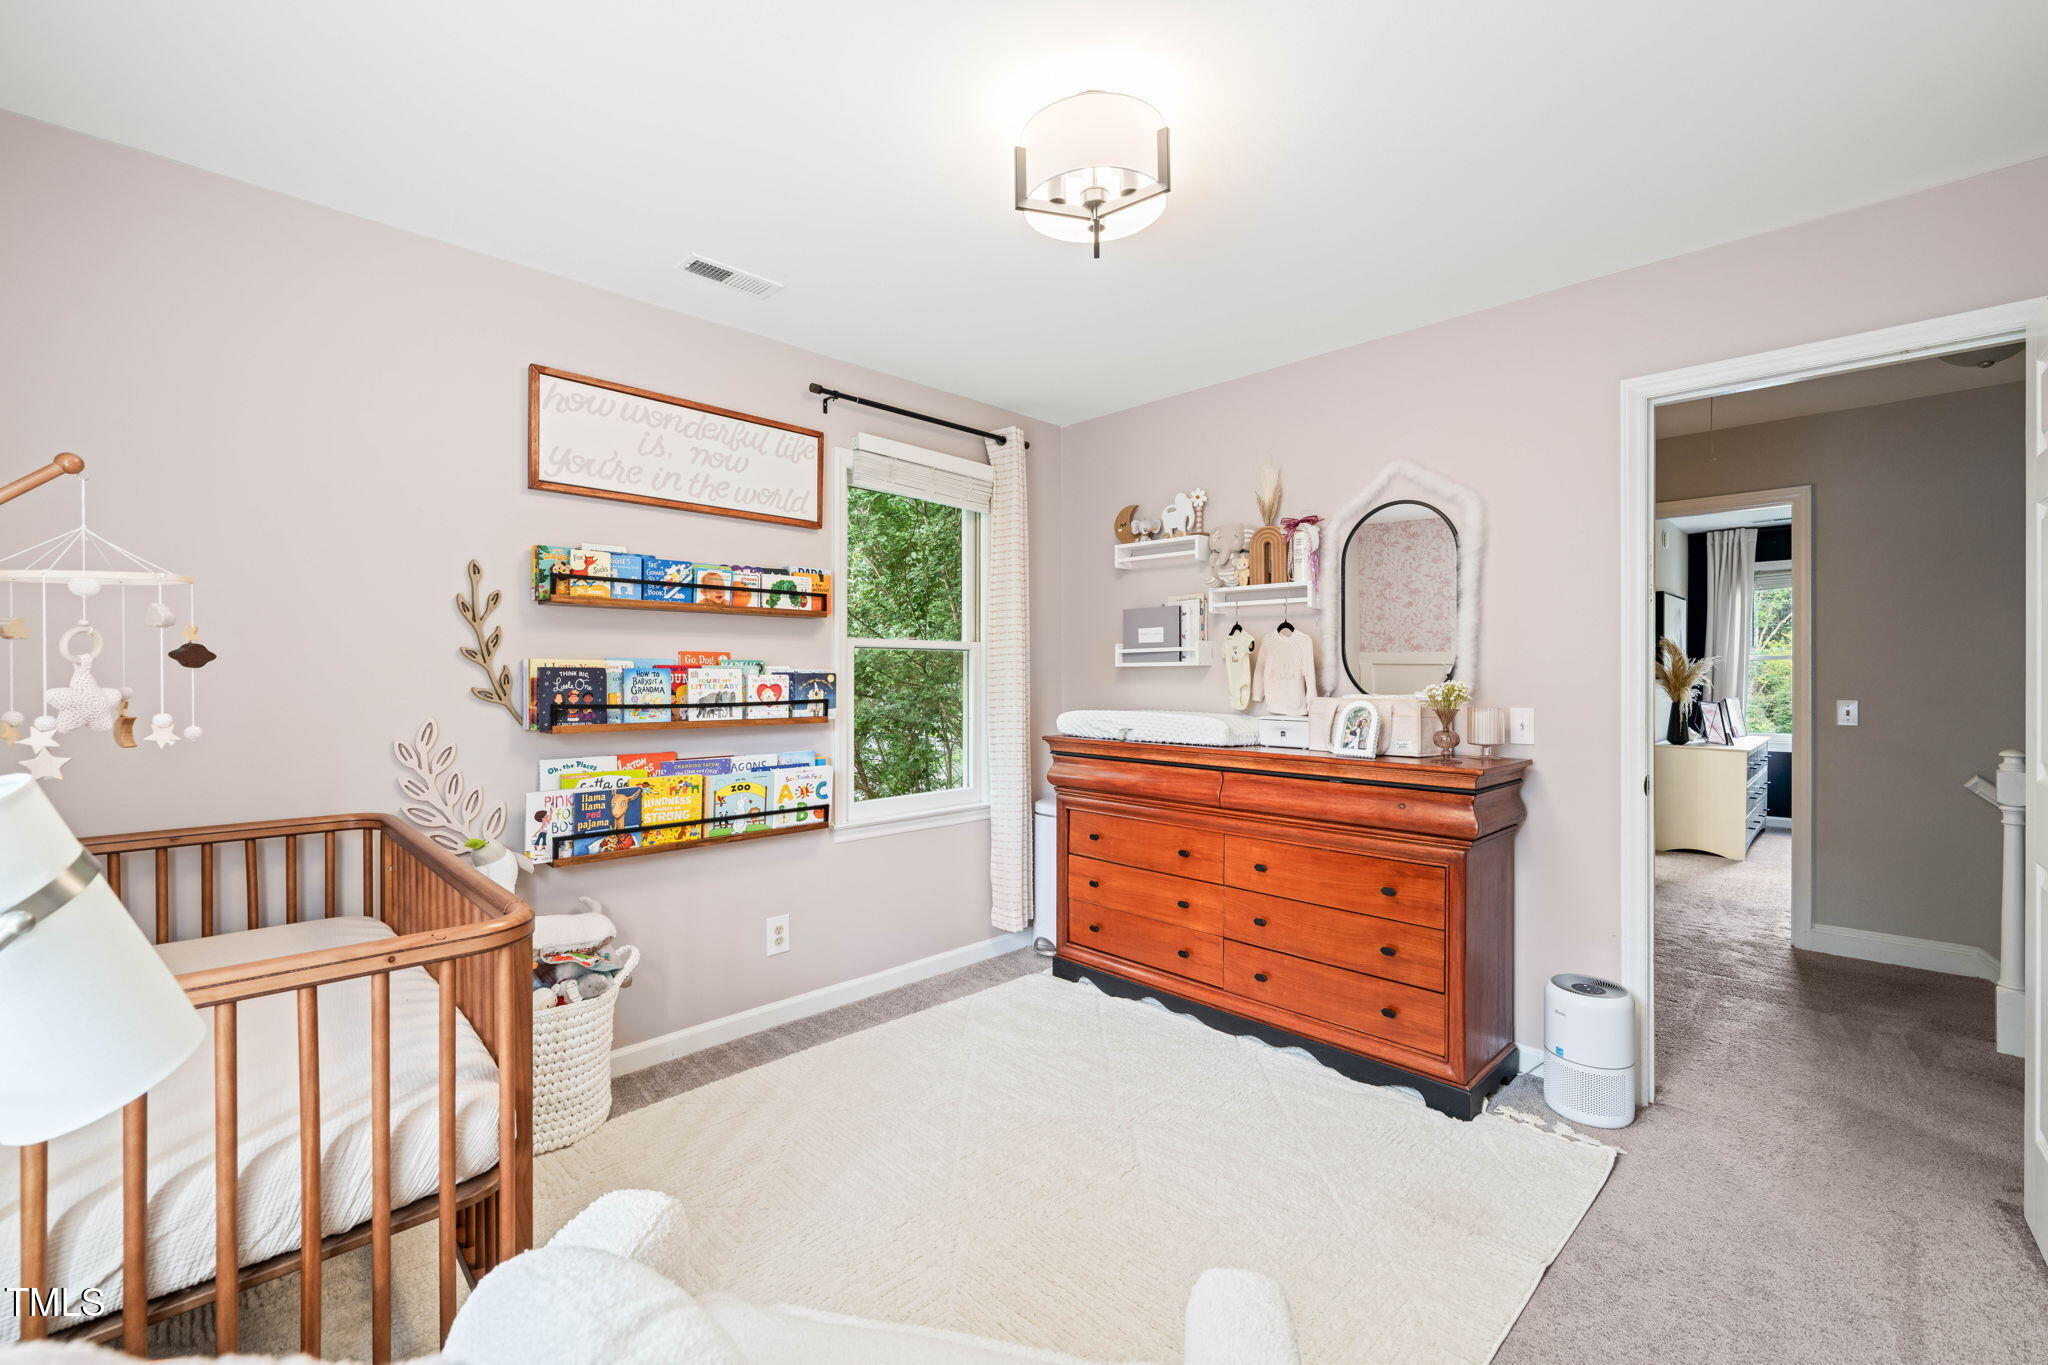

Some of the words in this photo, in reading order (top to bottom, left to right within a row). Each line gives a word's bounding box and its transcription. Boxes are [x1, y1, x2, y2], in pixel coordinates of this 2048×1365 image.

[542, 381, 616, 421] how
[620, 402, 768, 452] wonderful
[775, 437, 816, 464] life
[690, 446, 749, 473] now
[544, 445, 644, 485] you're
[651, 467, 681, 492] in
[688, 472, 730, 501] the
[734, 486, 810, 514] world
[573, 554, 584, 562] Fox
[593, 566, 608, 574] Socks
[553, 678, 574, 692] Little
[575, 678, 592, 690] One
[632, 677, 657, 685] BABYSIT
[631, 686, 665, 695] GRANDMA
[548, 767, 561, 775] Oh,
[576, 761, 597, 771] Places
[730, 760, 767, 773] AGONS
[777, 784, 794, 804] A
[815, 781, 828, 800] C
[581, 802, 606, 810] llama
[644, 796, 691, 807] KINDNESS
[585, 810, 602, 819] red
[644, 810, 690, 823] STRONG
[796, 802, 808, 822] B
[577, 819, 609, 831] pajama
